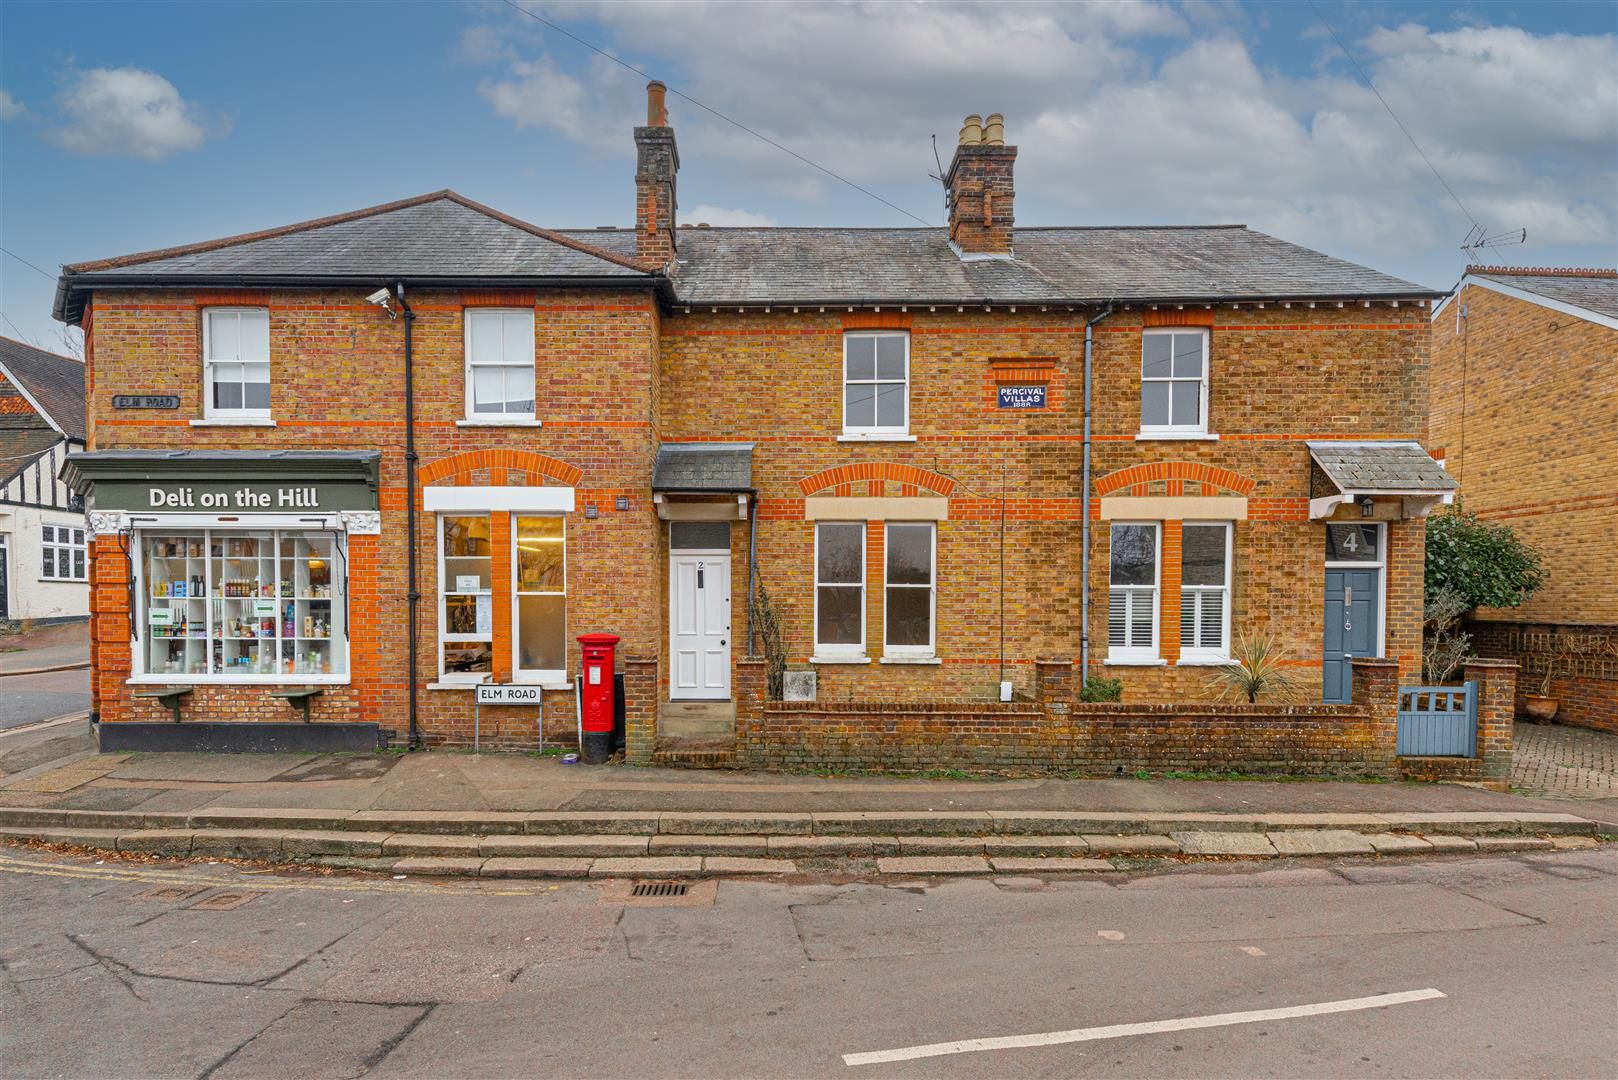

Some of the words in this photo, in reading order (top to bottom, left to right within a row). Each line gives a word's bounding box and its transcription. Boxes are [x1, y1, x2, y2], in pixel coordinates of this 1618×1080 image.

[1000, 388, 1044, 396] PERCIVAL
[119, 397, 141, 408] ELM
[145, 397, 173, 408] ROAD
[1003, 395, 1040, 403] VILLAS
[149, 488, 196, 508] Deli
[200, 492, 229, 508] on
[234, 488, 272, 508] the
[278, 488, 320, 508] Hill
[1343, 532, 1359, 552] 4
[698, 560, 704, 570] 2
[481, 689, 502, 699] ELM
[508, 689, 537, 699] ROAD
